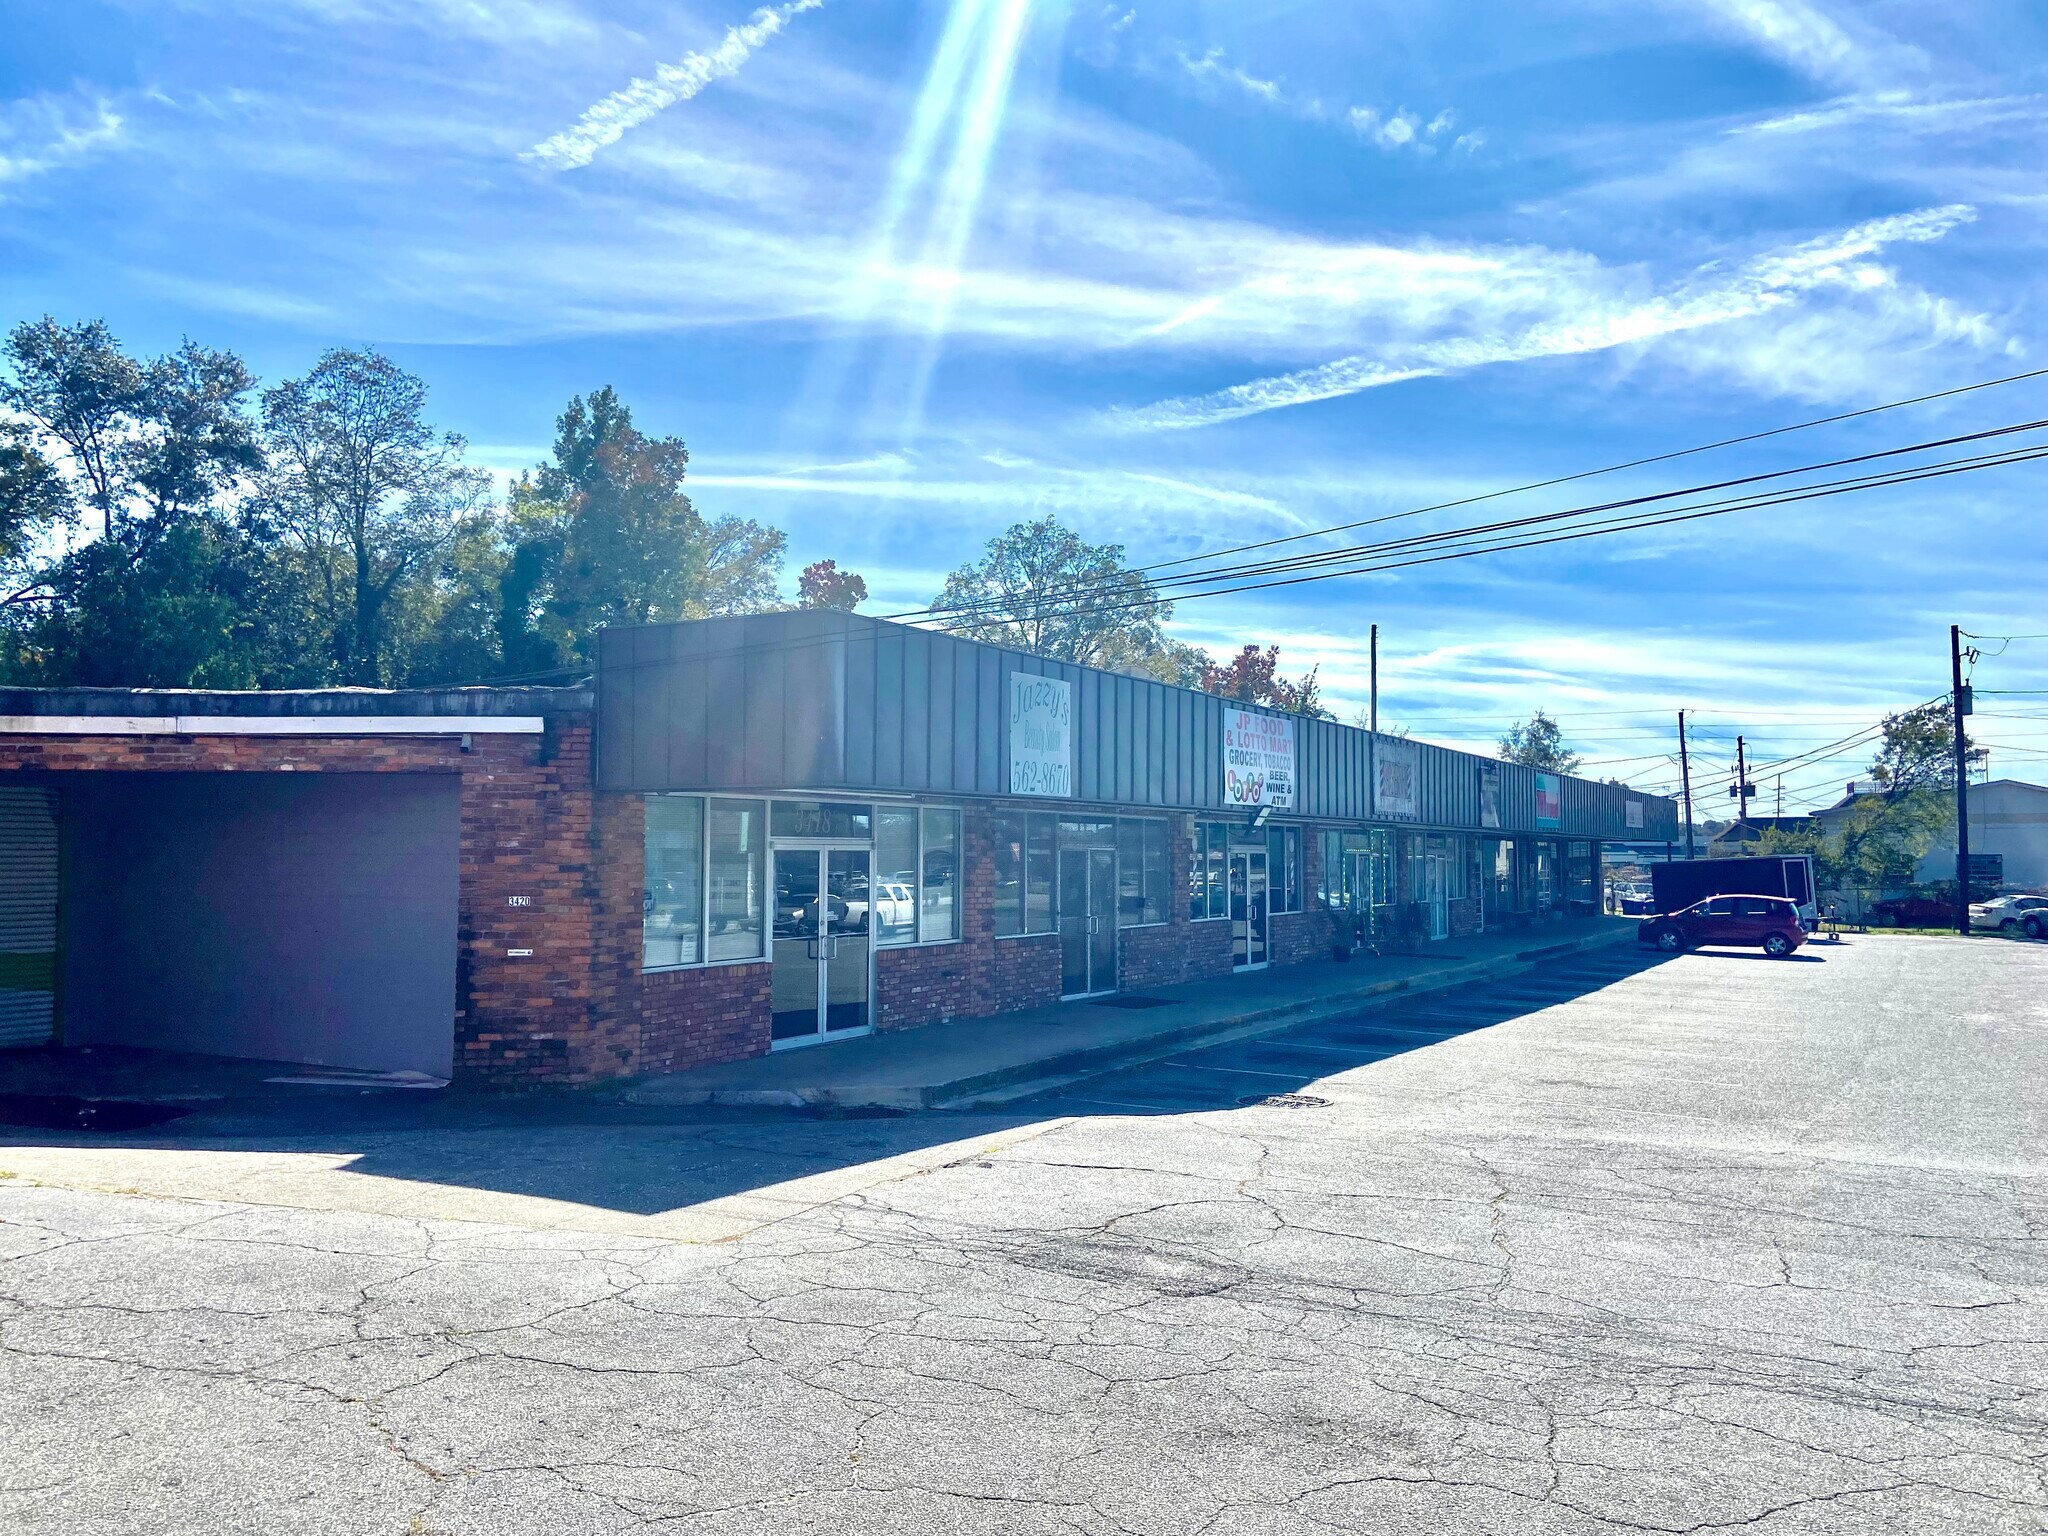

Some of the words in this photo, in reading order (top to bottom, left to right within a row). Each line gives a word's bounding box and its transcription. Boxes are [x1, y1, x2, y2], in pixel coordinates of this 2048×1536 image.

[1013, 680, 1069, 726] Jazzy's
[1236, 713, 1250, 730] JP
[1255, 718, 1284, 736] FOOD
[1226, 730, 1233, 746] &
[1238, 731, 1267, 751] LOTTO
[1269, 736, 1292, 754] MART
[1229, 749, 1263, 770] GROCERY,
[1264, 754, 1291, 771] TOBACCO
[1013, 761, 1069, 794] 562-8670
[1269, 770, 1290, 783] BEER,
[1266, 782, 1285, 793] WINE
[1287, 785, 1292, 794] &
[1271, 795, 1287, 806] ATM
[795, 809, 831, 833] 3418
[509, 896, 530, 906] 3420
